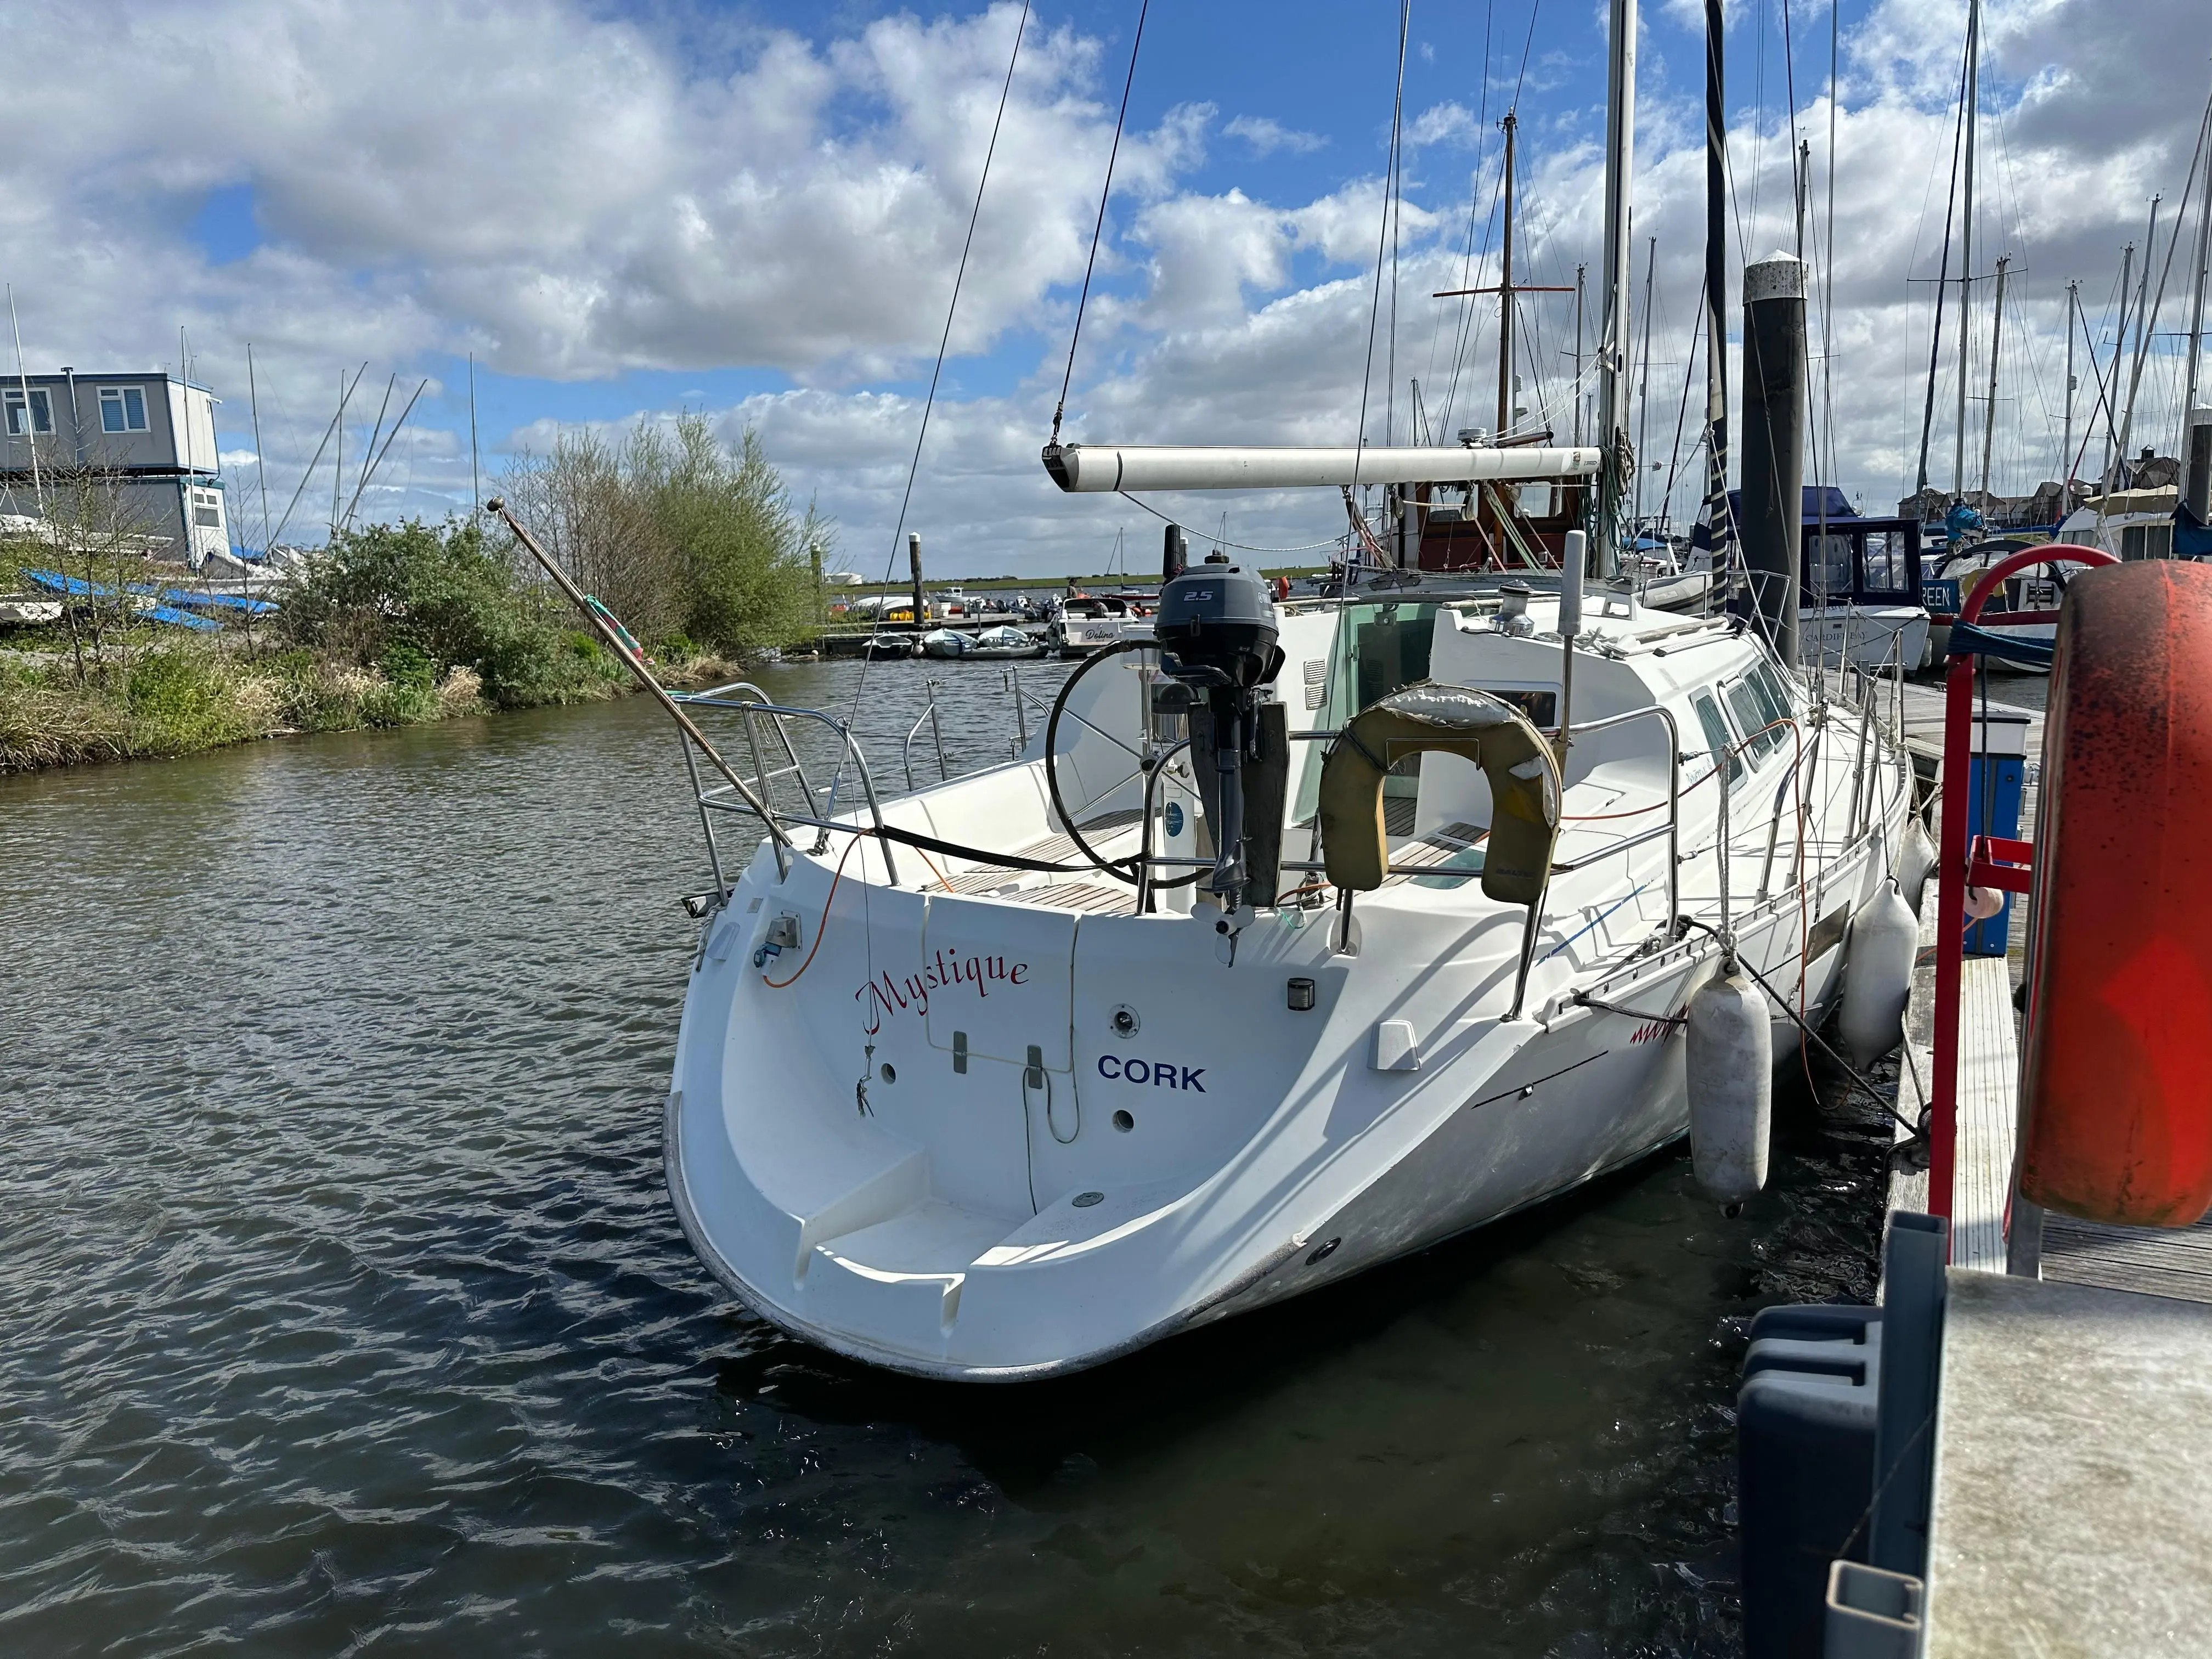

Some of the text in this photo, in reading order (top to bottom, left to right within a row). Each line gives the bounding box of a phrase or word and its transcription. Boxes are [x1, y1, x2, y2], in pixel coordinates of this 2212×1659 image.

[1183, 591, 1214, 601] 2.5
[1086, 629, 1115, 639] Dolina
[855, 948, 1029, 1035] Mystique
[1098, 1055, 1206, 1093] CORK
